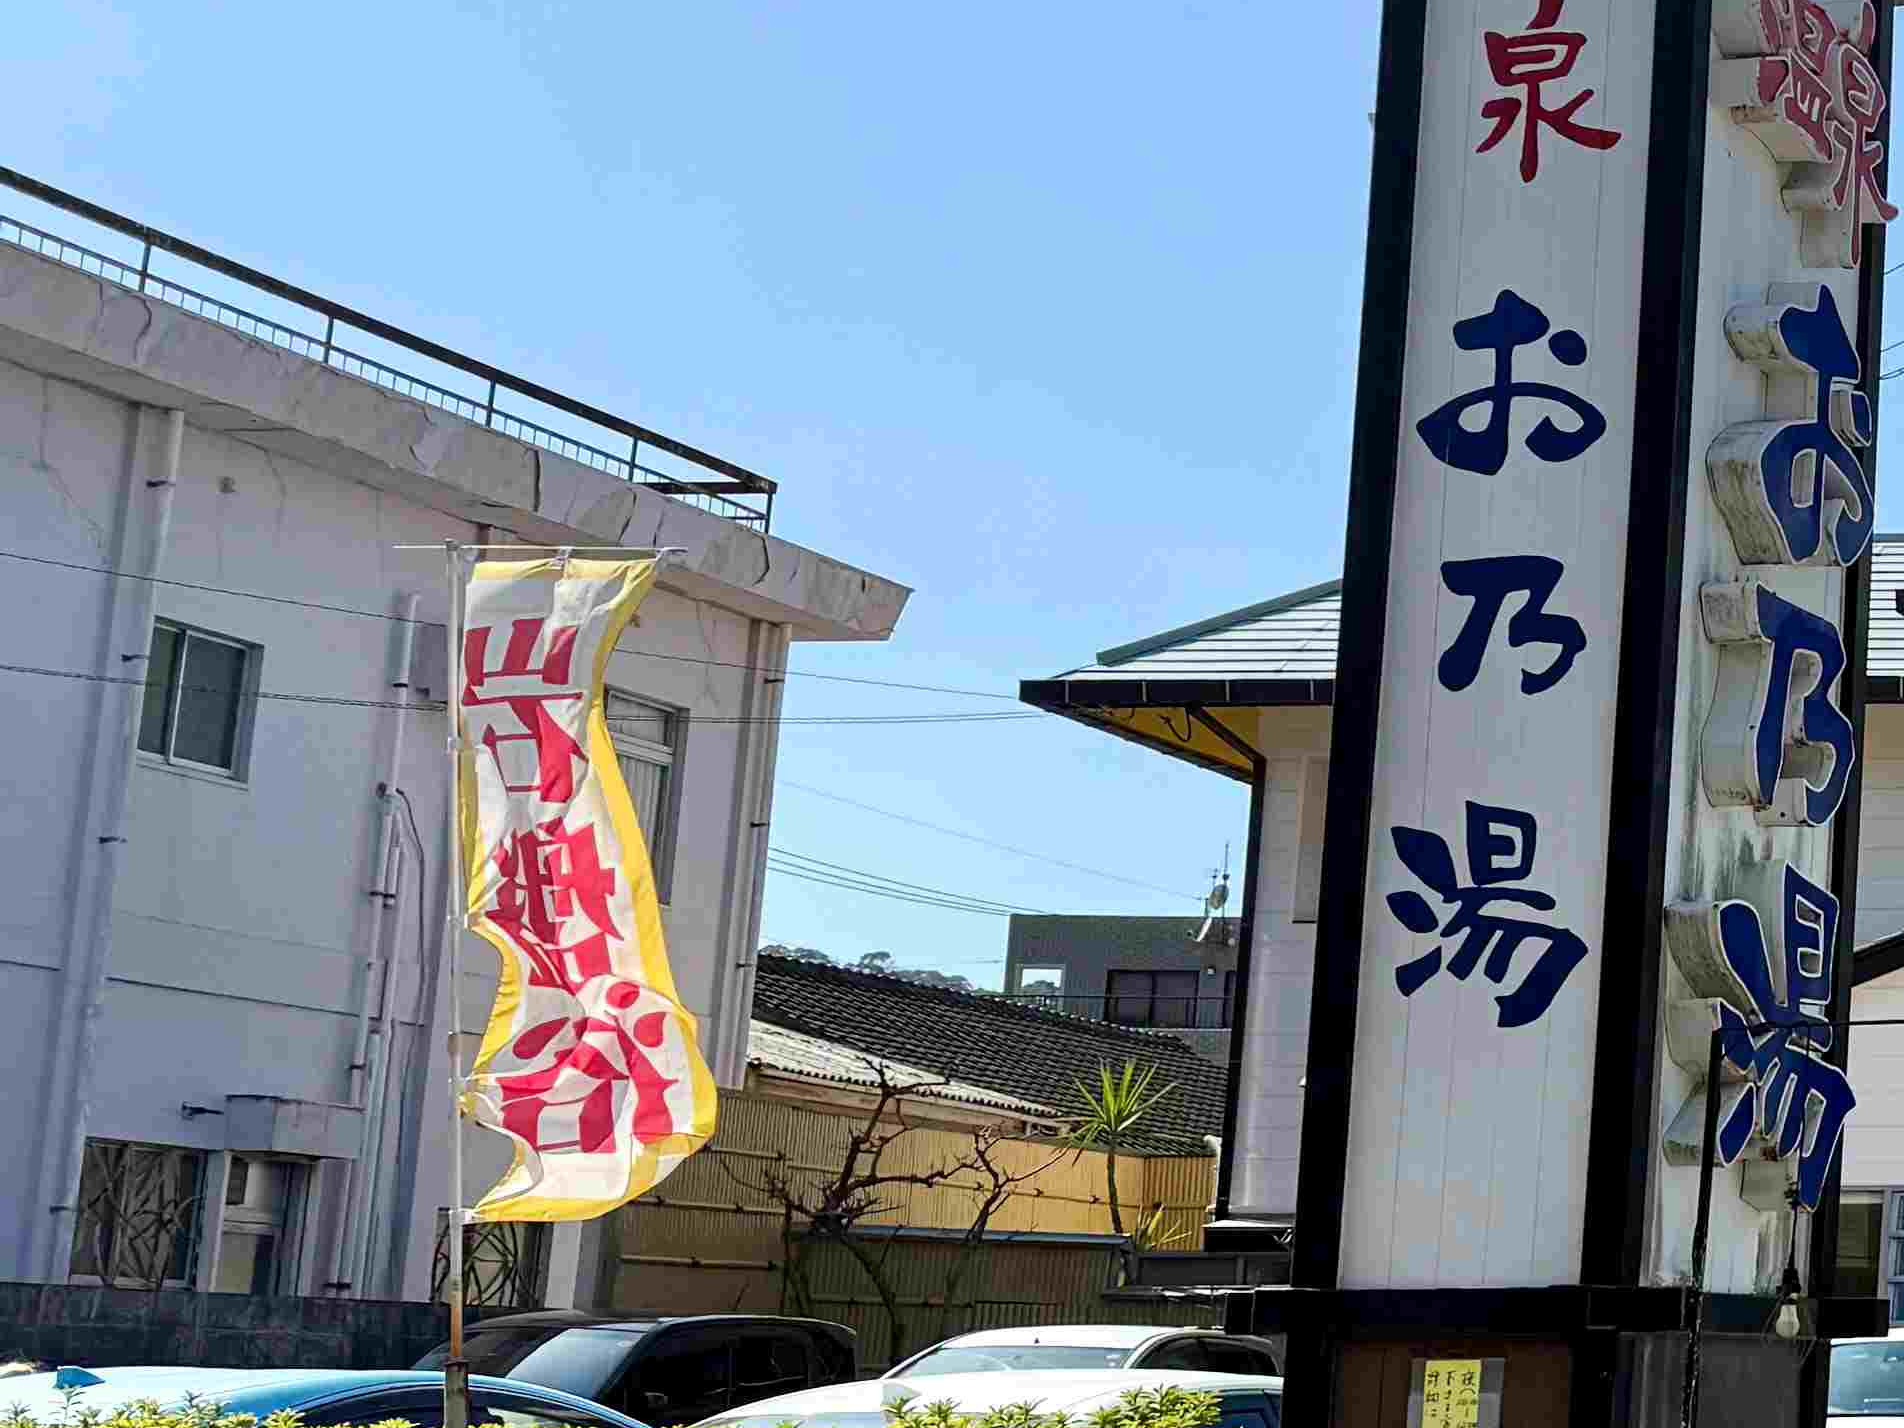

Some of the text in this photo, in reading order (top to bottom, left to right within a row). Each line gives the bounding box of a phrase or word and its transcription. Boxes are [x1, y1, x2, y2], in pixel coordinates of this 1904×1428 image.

[1384, 288, 1608, 1029] お乃湯
[1717, 283, 1875, 1214] お乃湯
